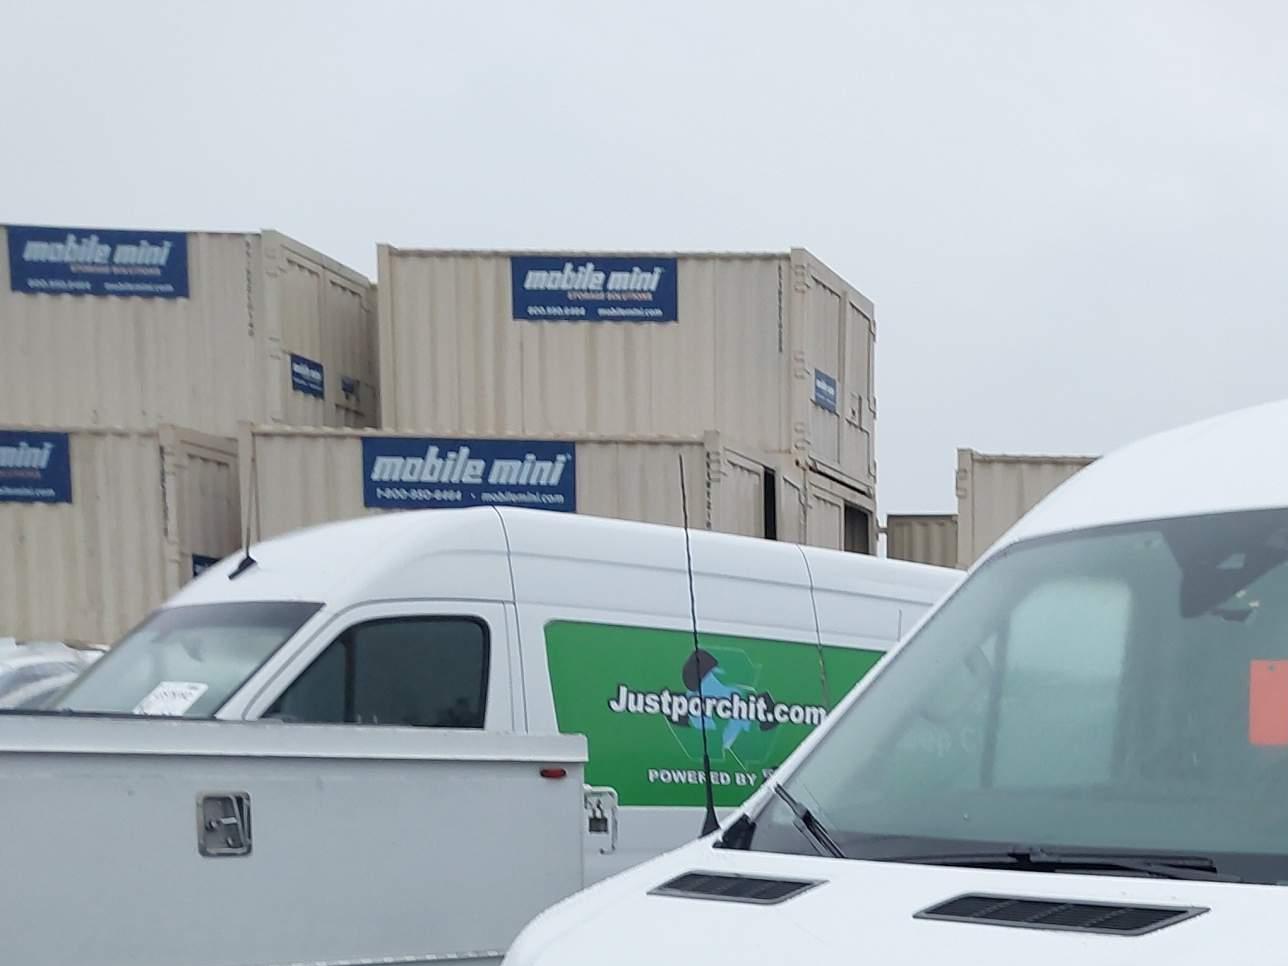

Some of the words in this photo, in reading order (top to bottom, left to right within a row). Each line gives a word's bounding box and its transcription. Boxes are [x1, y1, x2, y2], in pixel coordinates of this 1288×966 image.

[23, 233, 111, 263] mobile
[112, 239, 172, 266] mini
[524, 262, 605, 290] mobile
[607, 266, 662, 291] mini
[371, 445, 485, 484] mobile
[488, 453, 566, 486] mini
[609, 685, 827, 725] Justporchit.com
[735, 773, 757, 787] BY
